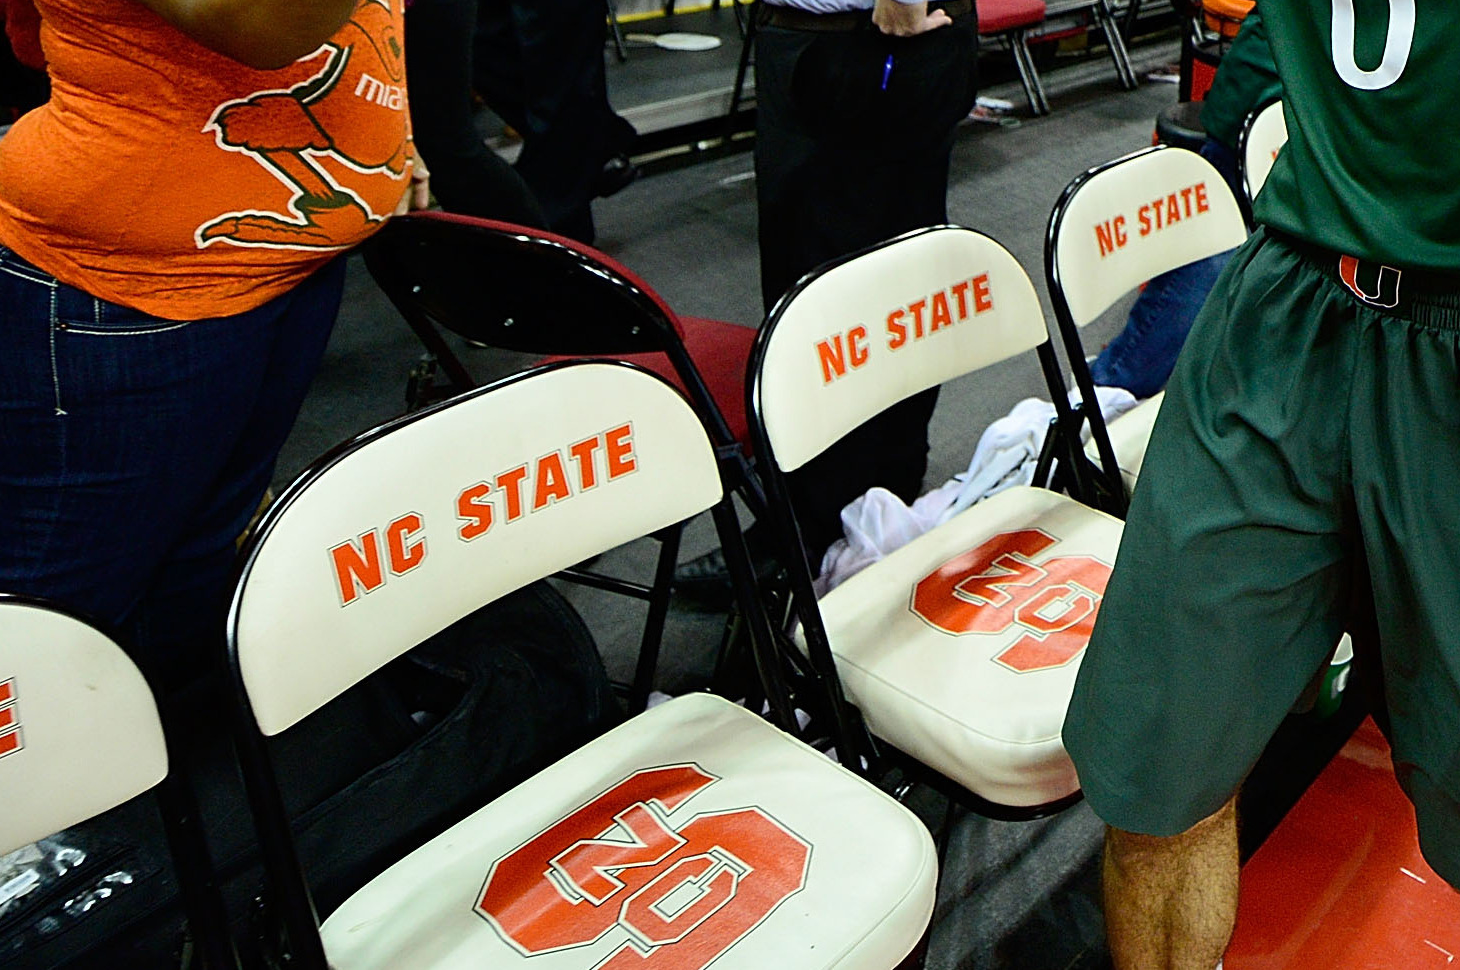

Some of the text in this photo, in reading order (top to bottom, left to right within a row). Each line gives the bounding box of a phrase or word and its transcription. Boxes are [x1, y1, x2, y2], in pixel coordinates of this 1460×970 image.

[1094, 181, 1210, 258] NC STATE
[815, 270, 994, 387] NC STATE
[1339, 254, 1402, 308] U
[327, 420, 639, 608] NC STATE
